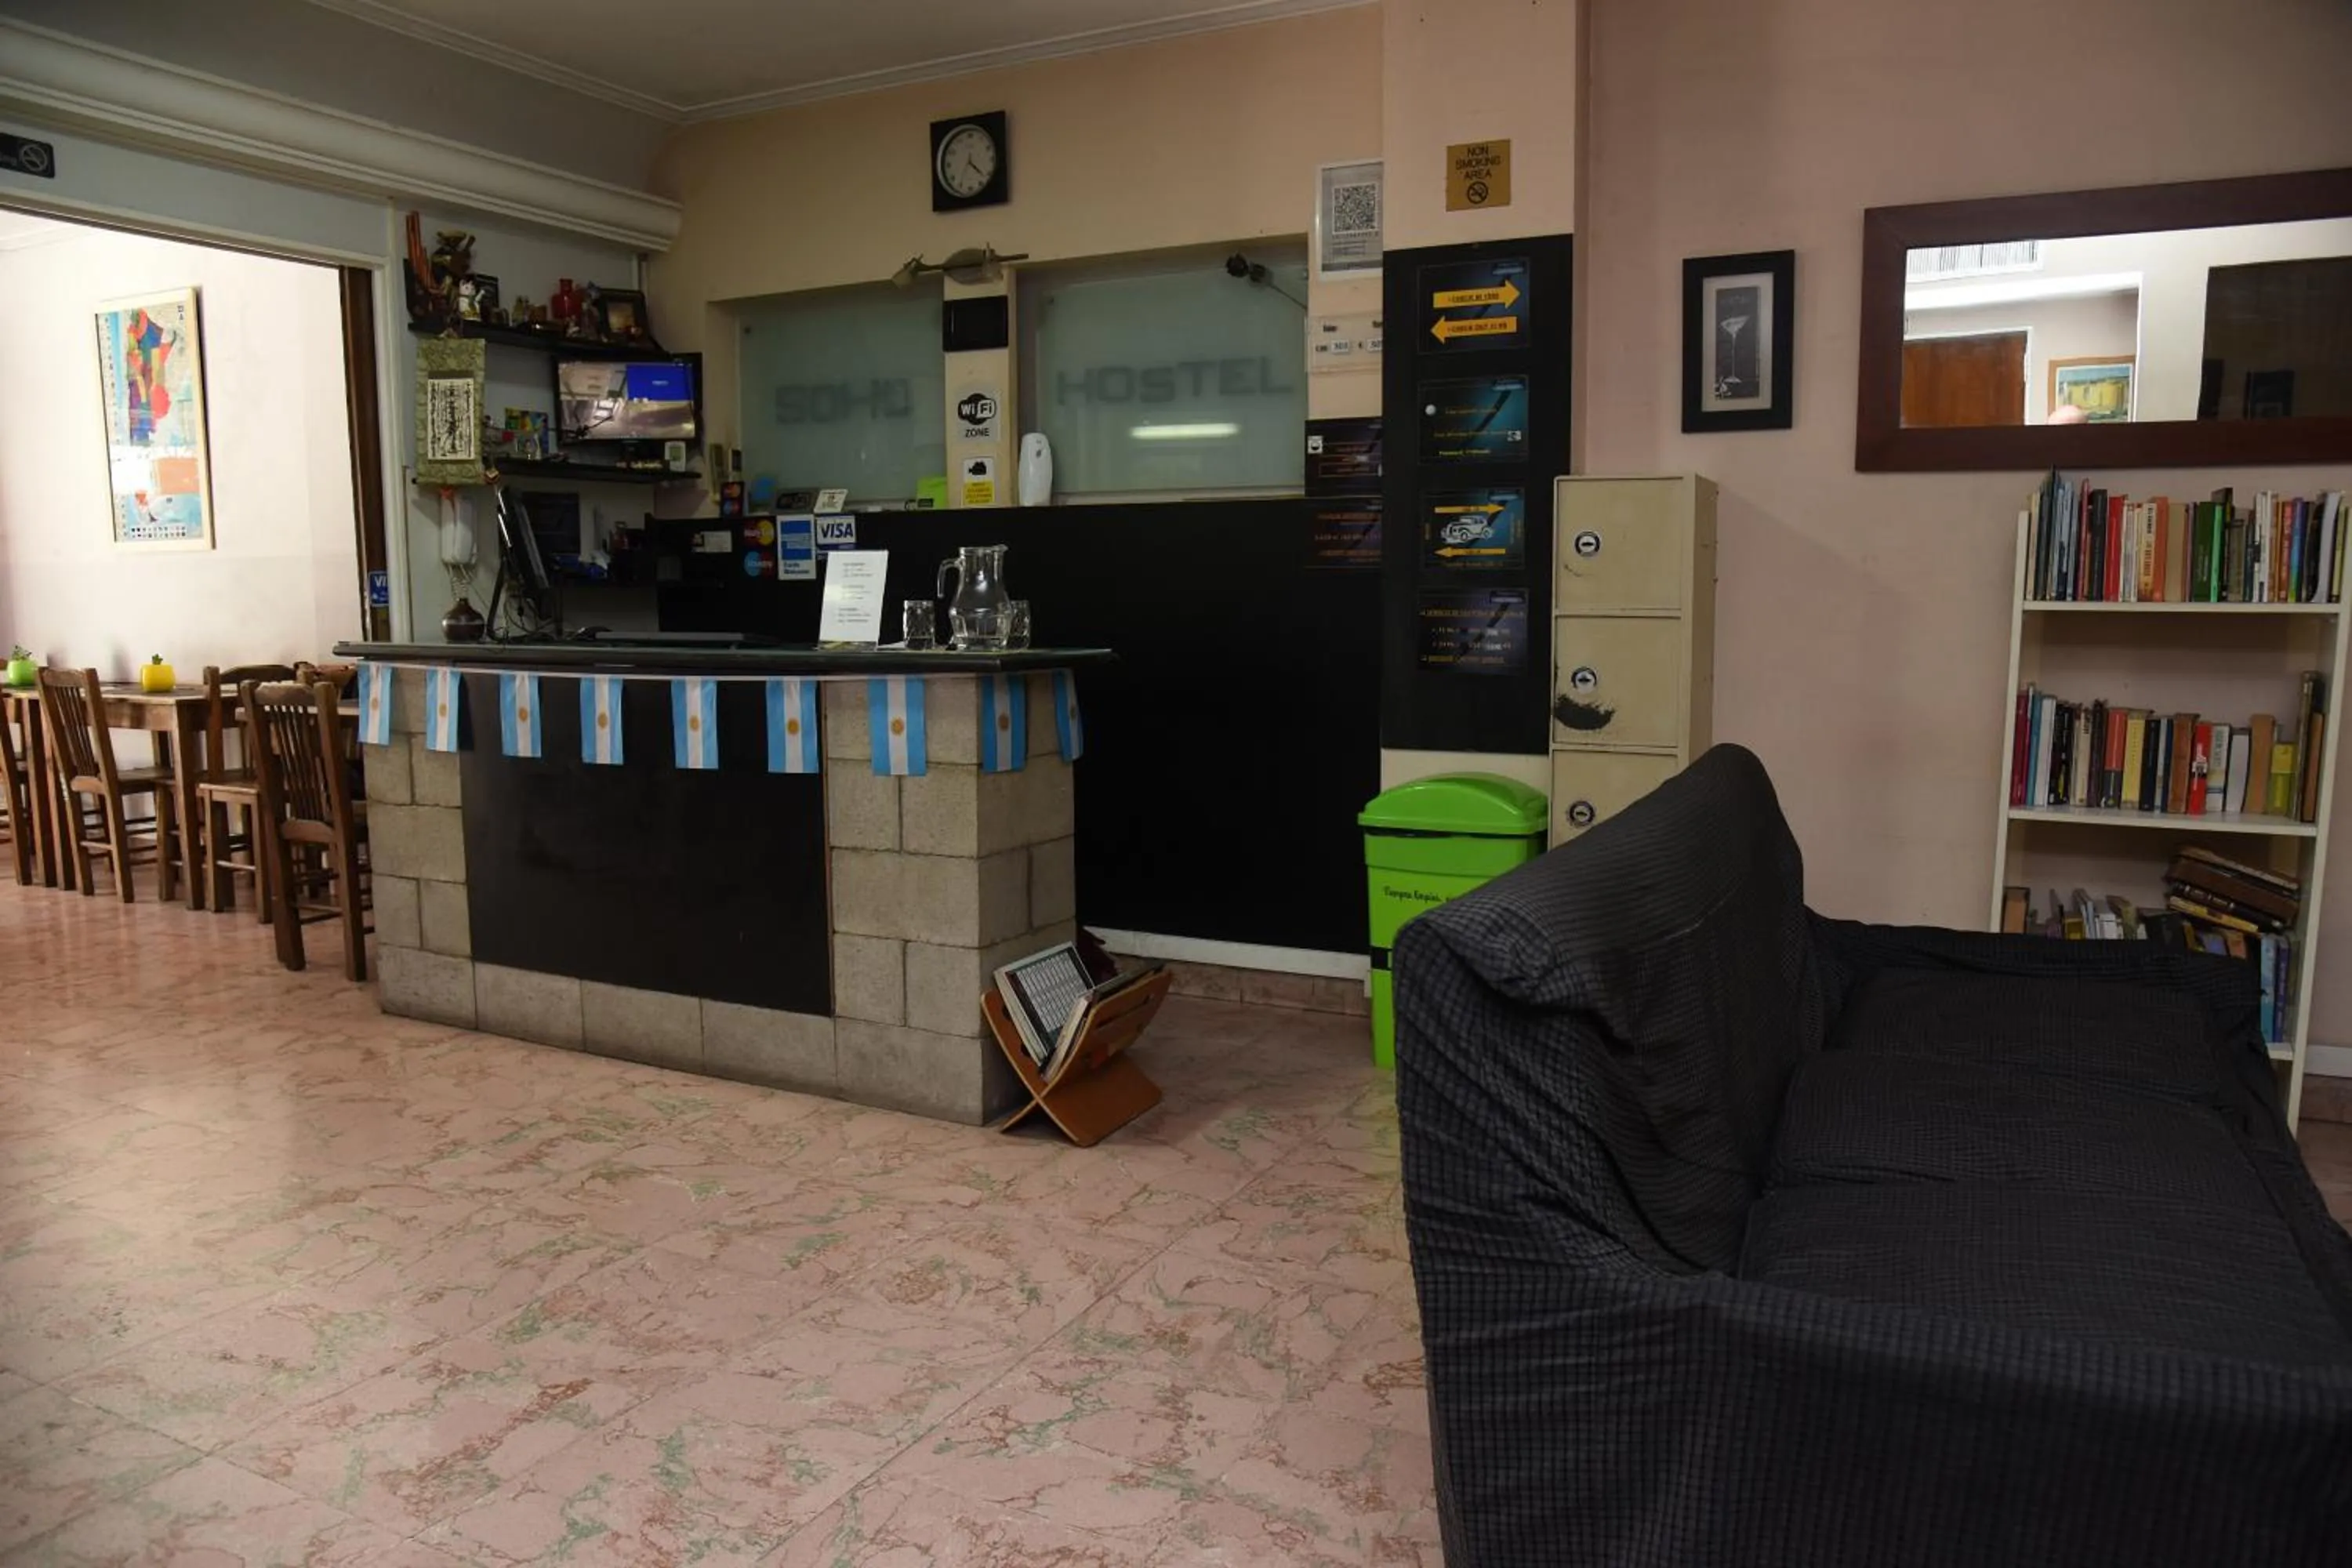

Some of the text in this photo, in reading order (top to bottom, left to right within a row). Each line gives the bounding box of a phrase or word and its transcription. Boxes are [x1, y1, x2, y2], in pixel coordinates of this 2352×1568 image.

[1467, 144, 1489, 157] NON
[1455, 155, 1501, 170] SMOKING
[1464, 169, 1492, 180] AREA
[775, 356, 1294, 424] SOHO HOSTEL
[965, 427, 990, 438] ZONE
[821, 523, 854, 539] VISA
